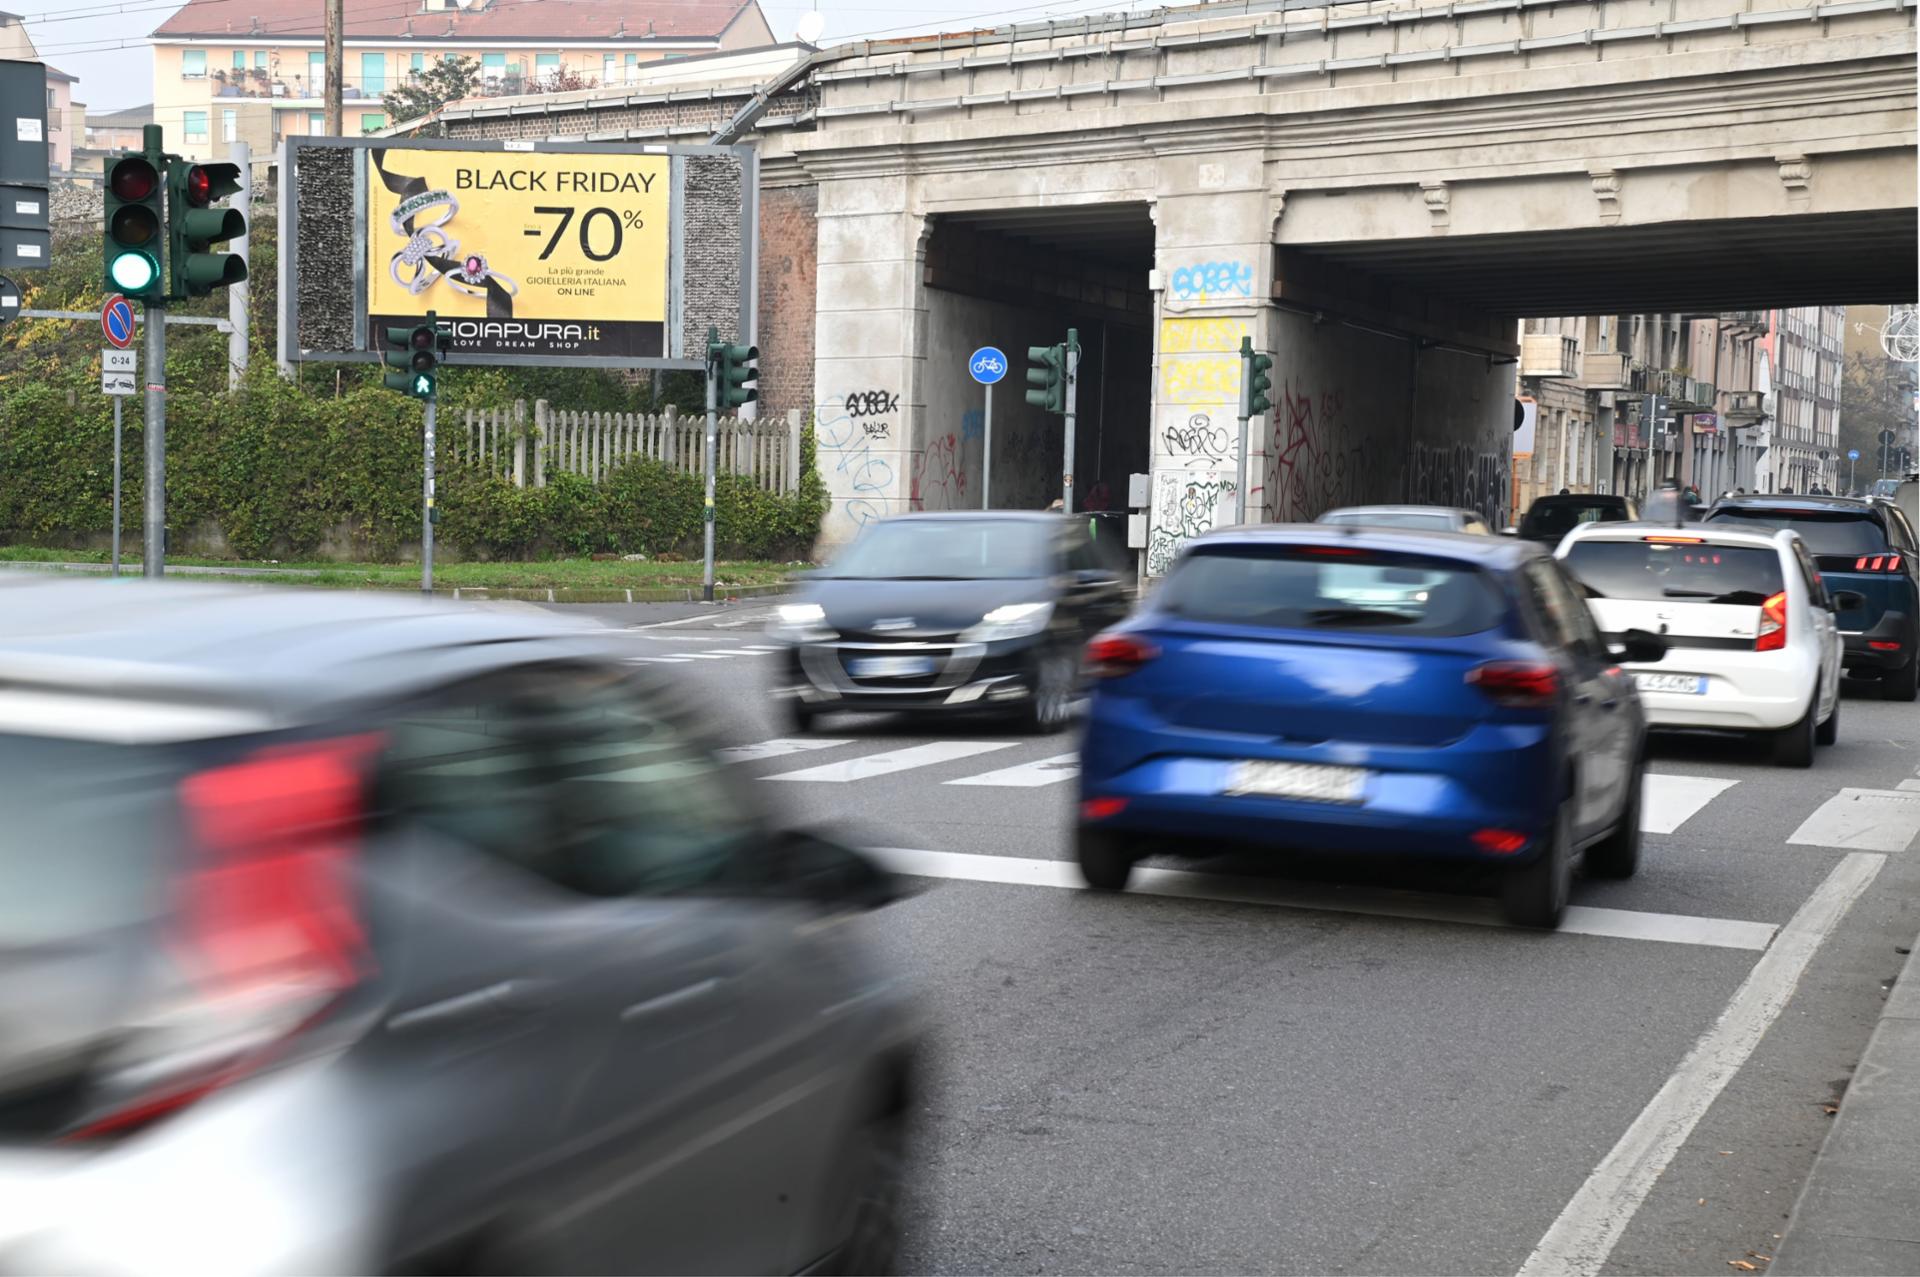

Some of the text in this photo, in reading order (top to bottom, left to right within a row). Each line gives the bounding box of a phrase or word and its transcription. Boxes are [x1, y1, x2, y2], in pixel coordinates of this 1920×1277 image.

[456, 168, 656, 193] BLACK FRIDAY
[548, 267, 559, 275] La
[575, 268, 605, 276] grande
[526, 276, 627, 286] GIOIELLERIA ITALIANA
[557, 288, 595, 296] ON LINE
[453, 339, 482, 347] LOVE
[111, 356, 130, 365] 0-24
